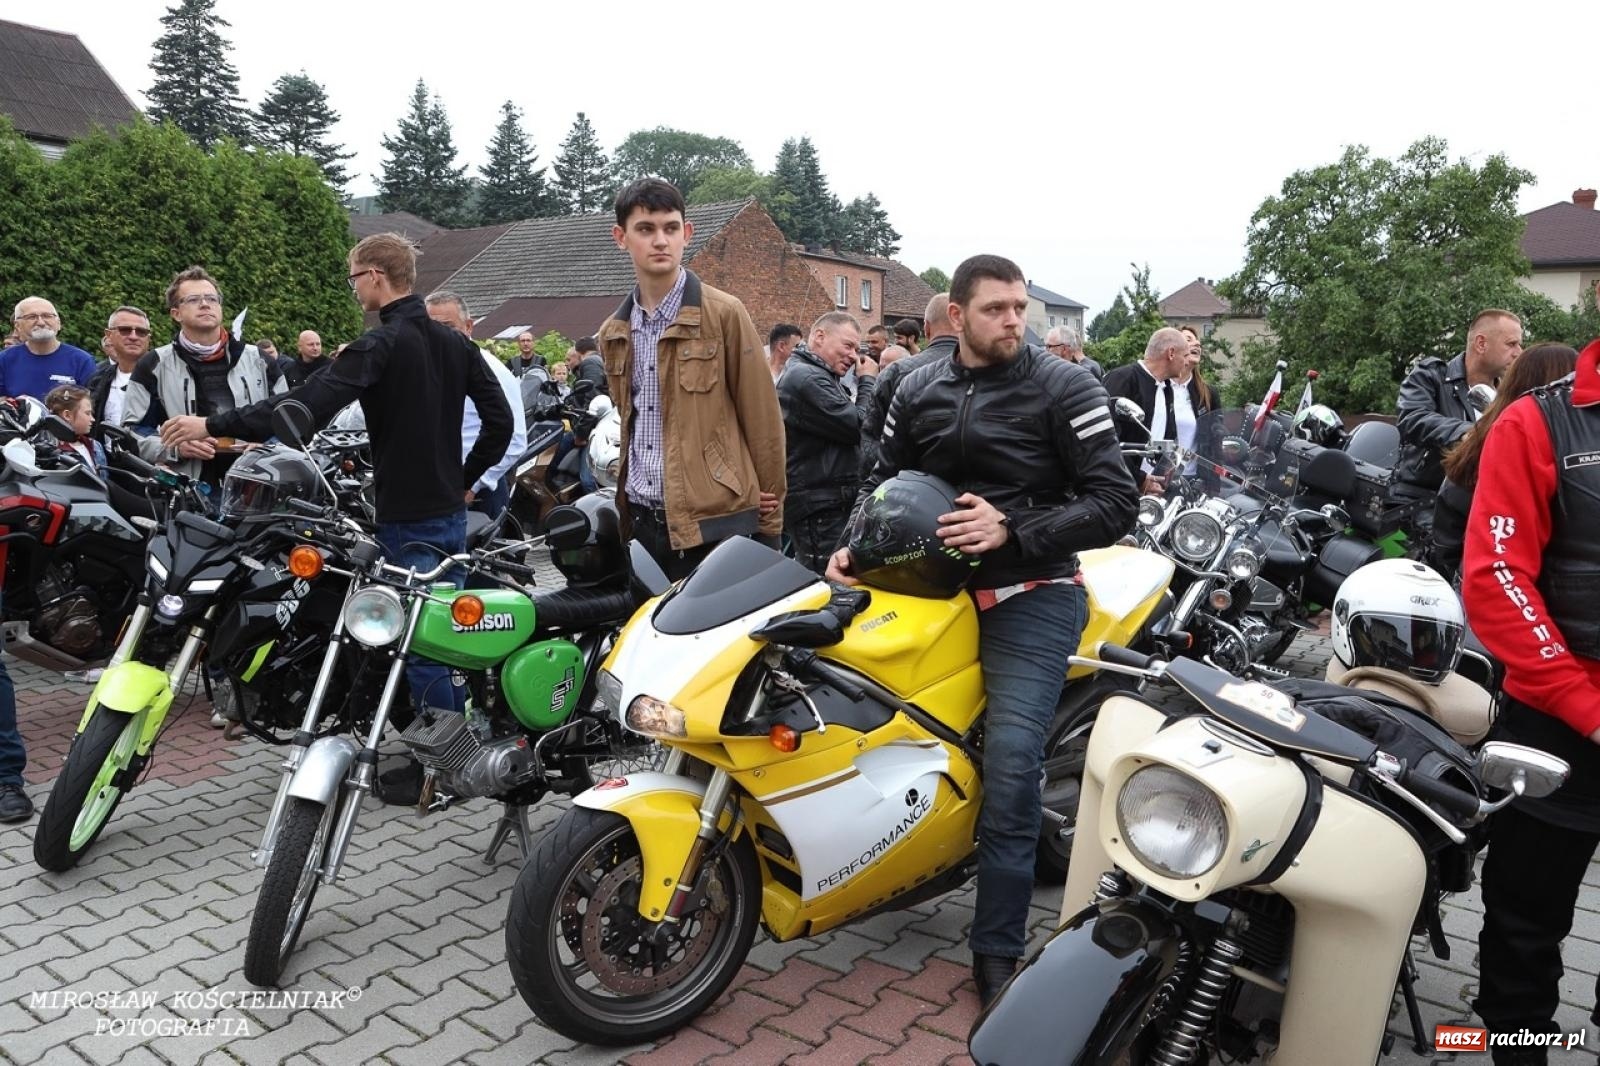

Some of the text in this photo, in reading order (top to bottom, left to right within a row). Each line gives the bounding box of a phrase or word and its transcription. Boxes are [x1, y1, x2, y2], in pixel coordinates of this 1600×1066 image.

[452, 613, 514, 632] son
[860, 611, 898, 632] DUCATI
[817, 794, 931, 891] PERFORMANCE
